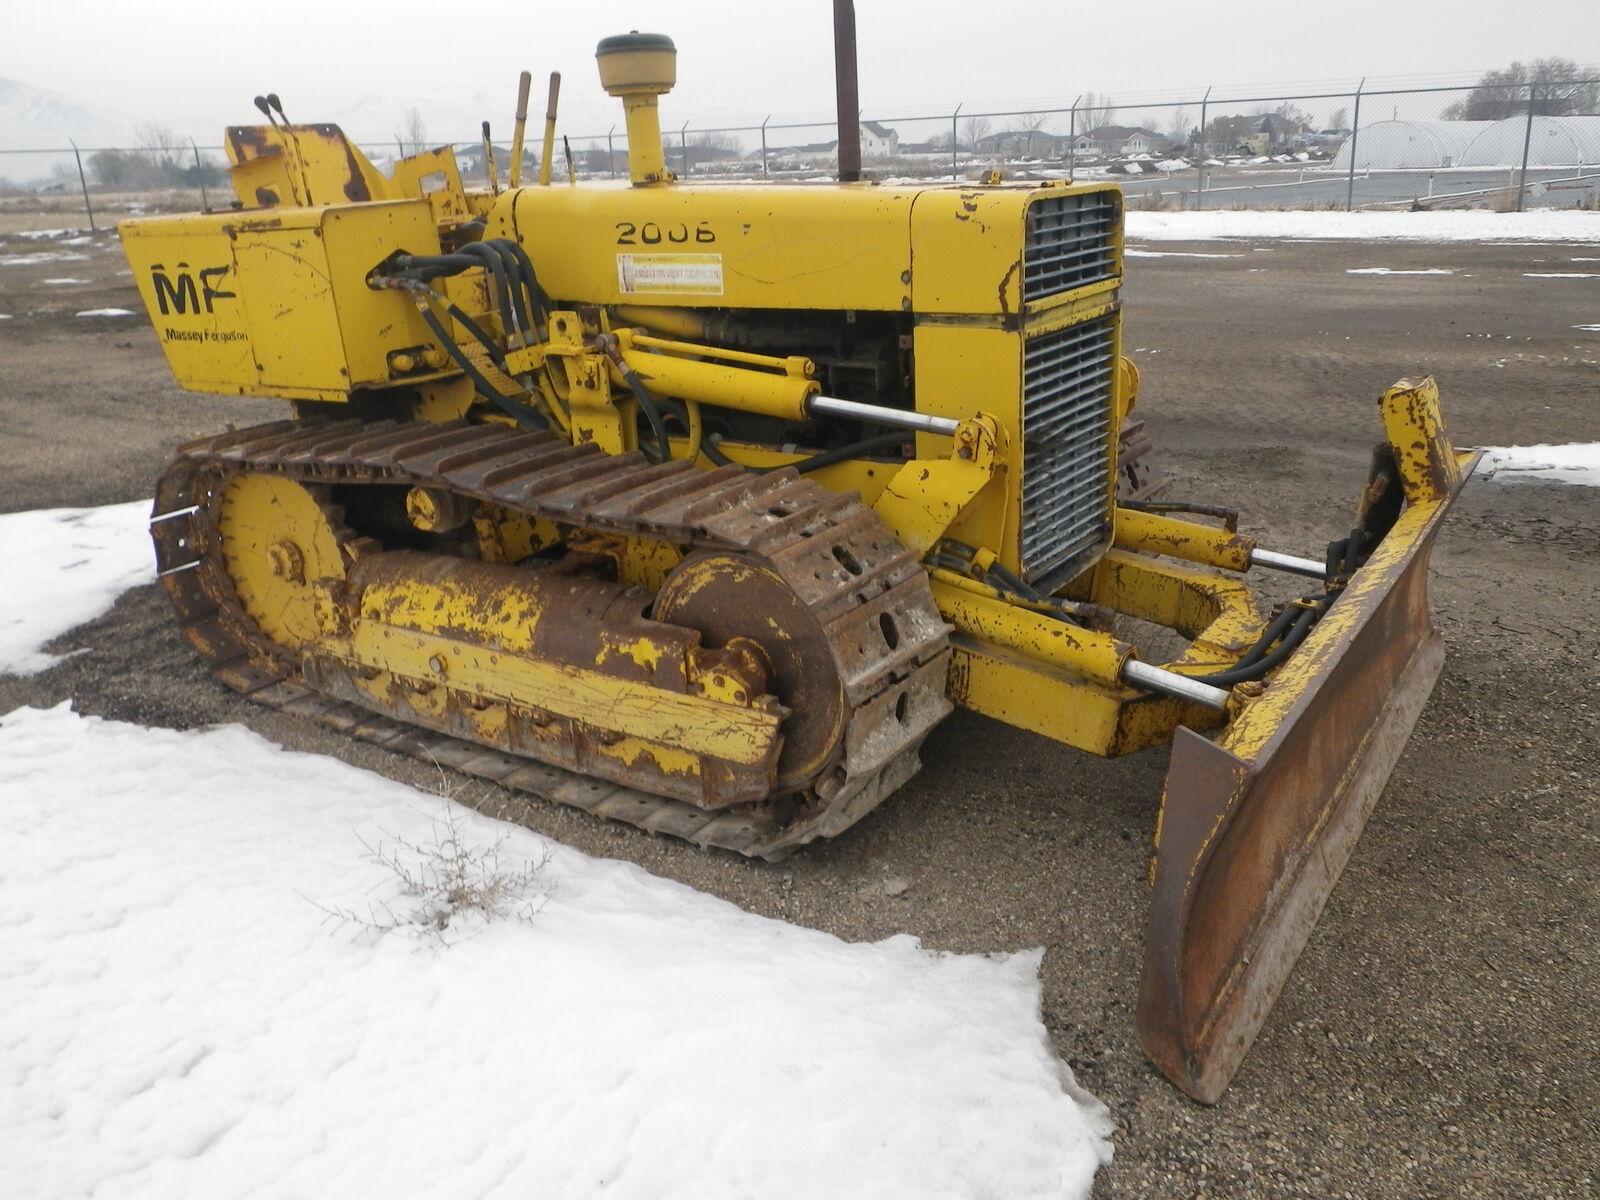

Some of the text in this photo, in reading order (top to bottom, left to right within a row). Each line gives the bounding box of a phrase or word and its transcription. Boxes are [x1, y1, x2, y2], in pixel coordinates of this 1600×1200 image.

[615, 222, 716, 245] 2006
[150, 261, 237, 316] MF
[165, 327, 249, 344] Massey Ferguson
